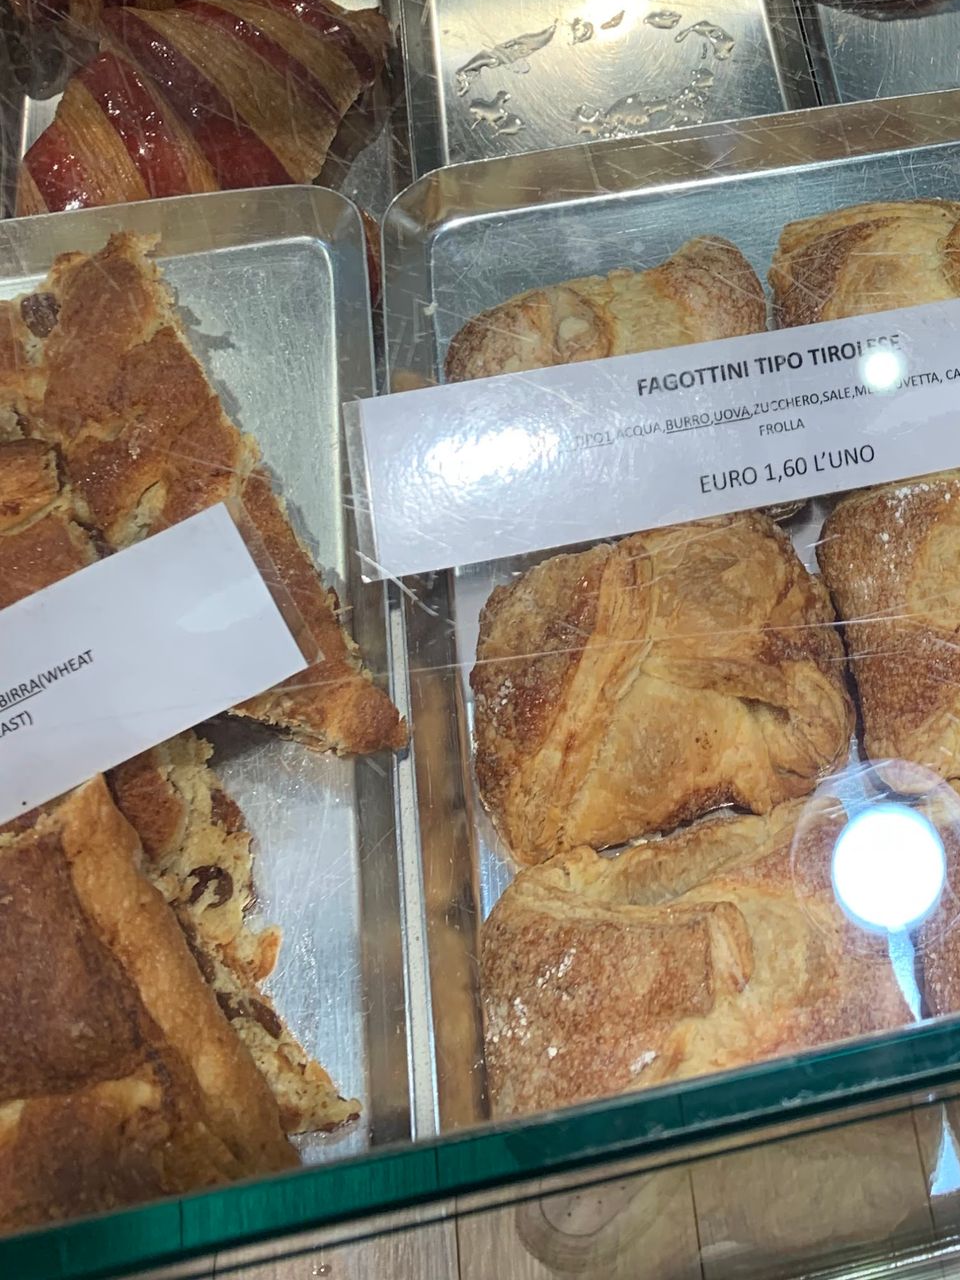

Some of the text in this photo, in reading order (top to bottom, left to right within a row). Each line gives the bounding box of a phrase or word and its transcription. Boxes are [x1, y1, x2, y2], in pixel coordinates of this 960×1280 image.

[637, 359, 750, 397] FAGOTTINI
[755, 351, 803, 376] TIPO
[759, 418, 805, 436] FROLLA
[700, 466, 757, 494] EURO
[764, 457, 807, 483] 1,60
[0, 710, 33, 738] AST)
